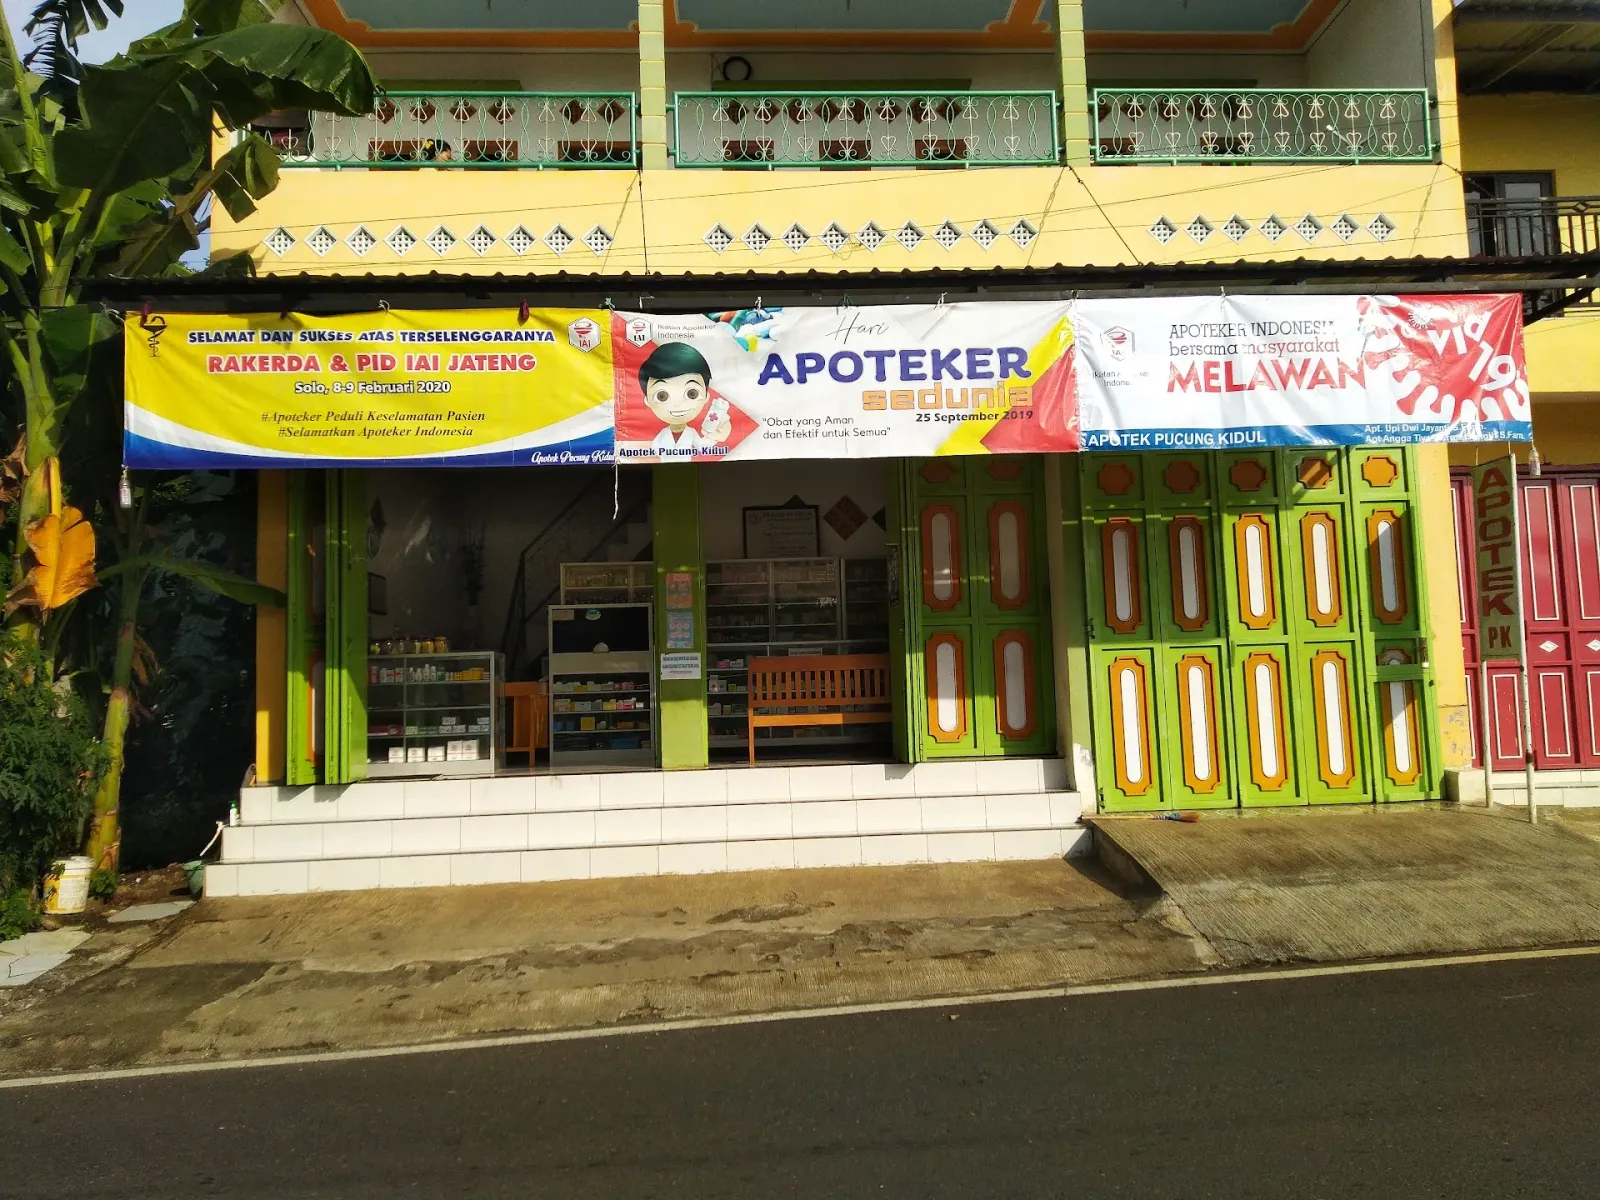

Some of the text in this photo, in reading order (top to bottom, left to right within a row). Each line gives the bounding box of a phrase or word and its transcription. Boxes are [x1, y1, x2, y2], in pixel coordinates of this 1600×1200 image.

[657, 331, 695, 339] Indonesia
[824, 311, 889, 345] Hari
[1168, 322, 1247, 339] APOTEKER
[188, 330, 554, 343] SELAMAT DAN SUKSES ATAS TERSELENGGARANYA
[579, 339, 591, 348] IAI
[1168, 340, 1238, 356] bersama
[208, 354, 536, 373] RAKERDA & PID IAI JATENG
[757, 346, 1032, 386] APOTEKER
[1167, 357, 1366, 394] MELAWAN
[294, 380, 451, 395] Solo, 8-9 Februari 2020
[862, 381, 1033, 411] sedunia
[261, 410, 485, 422] #Apoteker Peduli Keselamatan Pasien
[762, 415, 854, 428] "Obat yang Aman
[916, 410, 1033, 424] 25 September 2019
[278, 425, 473, 439] #Selamatkan Apoteker Indonesia
[762, 430, 782, 439] dan
[785, 428, 819, 439] Efektif
[821, 428, 850, 438] untuk
[1385, 424, 1400, 433] Upi
[1402, 423, 1419, 432] Dwi
[1088, 430, 1266, 447] APOTEK PUCUNG KIDUL
[619, 446, 728, 458] Apotek Pucung Kidul
[1478, 466, 1515, 618] APOTEK
[1488, 624, 1512, 649] PK
